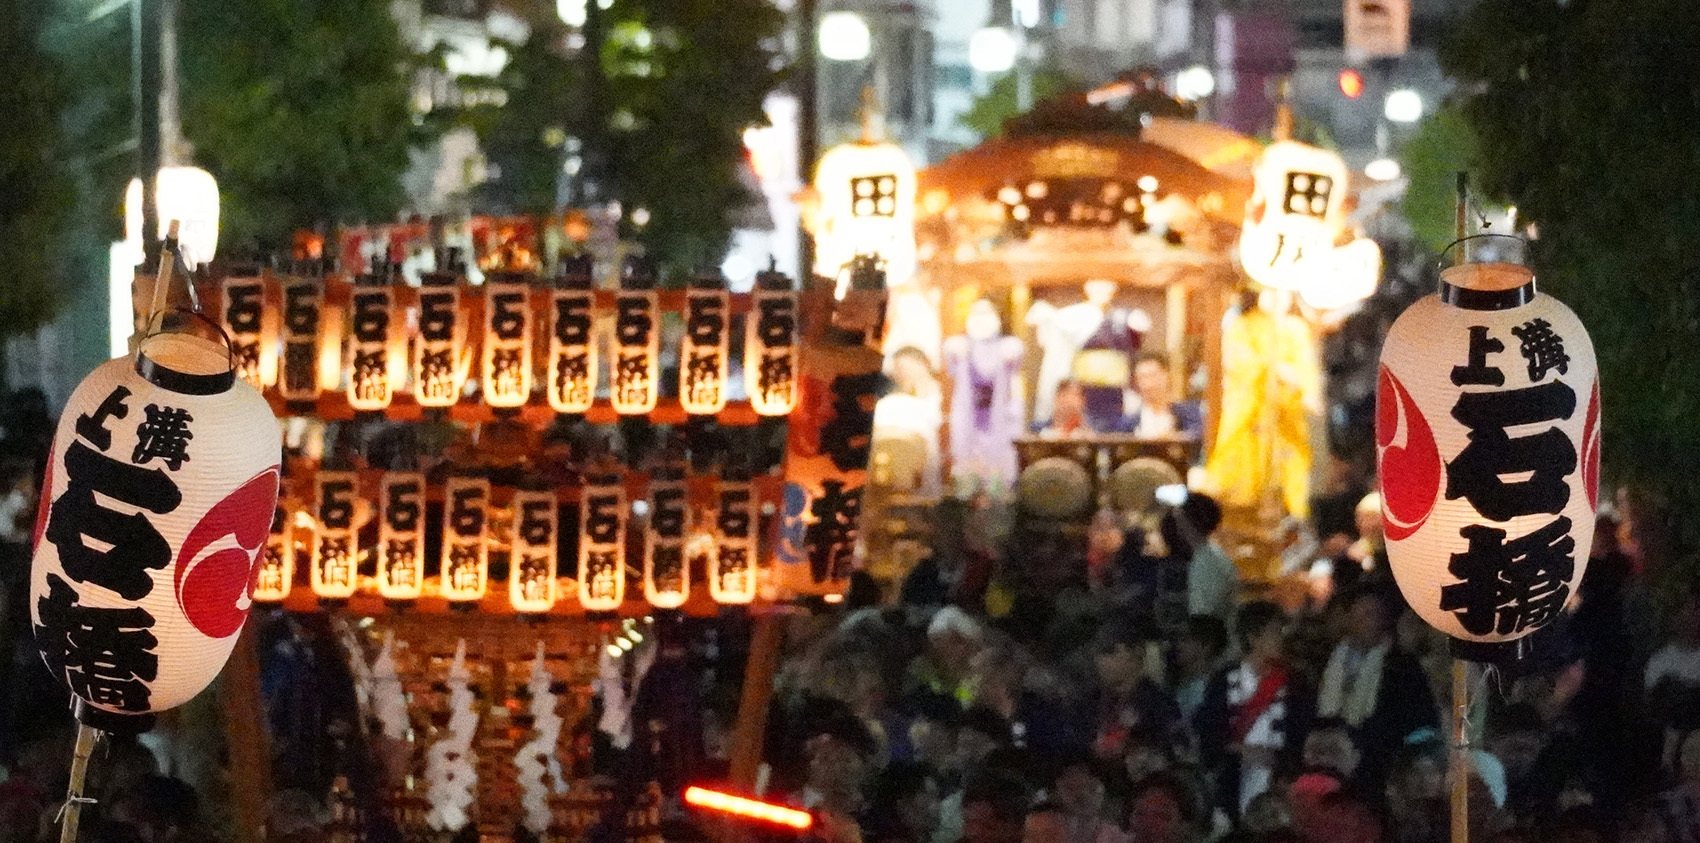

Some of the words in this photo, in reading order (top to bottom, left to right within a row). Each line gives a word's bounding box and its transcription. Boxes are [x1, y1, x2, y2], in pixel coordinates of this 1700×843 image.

[285, 284, 319, 391] 石
[1450, 317, 1571, 387] 上溝
[76, 384, 194, 472] 上溝
[1440, 377, 1578, 636] 石橋
[34, 438, 183, 711] 石橋
